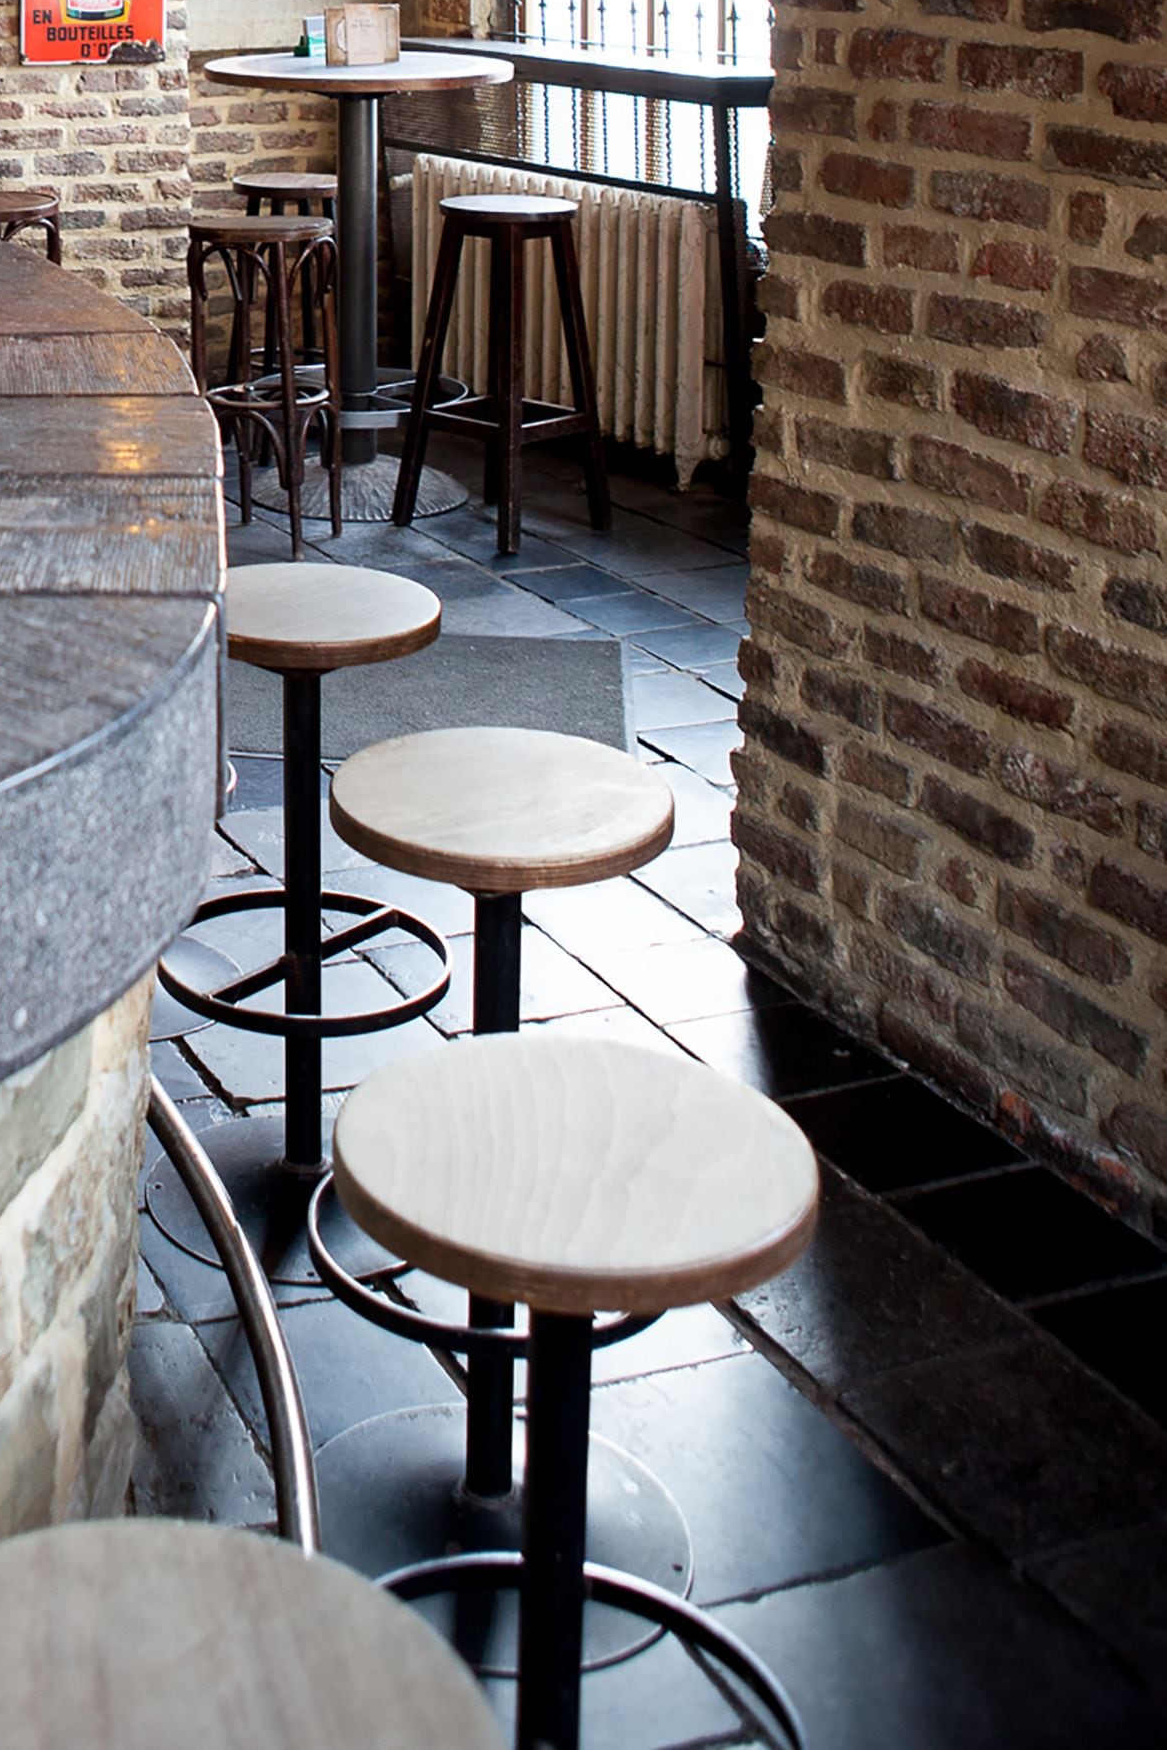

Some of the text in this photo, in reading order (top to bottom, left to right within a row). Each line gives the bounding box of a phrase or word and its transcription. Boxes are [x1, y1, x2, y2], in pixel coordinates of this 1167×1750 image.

[33, 10, 52, 24] EN
[47, 25, 134, 41] BOUTEILLES
[80, 43, 117, 58] D'O
